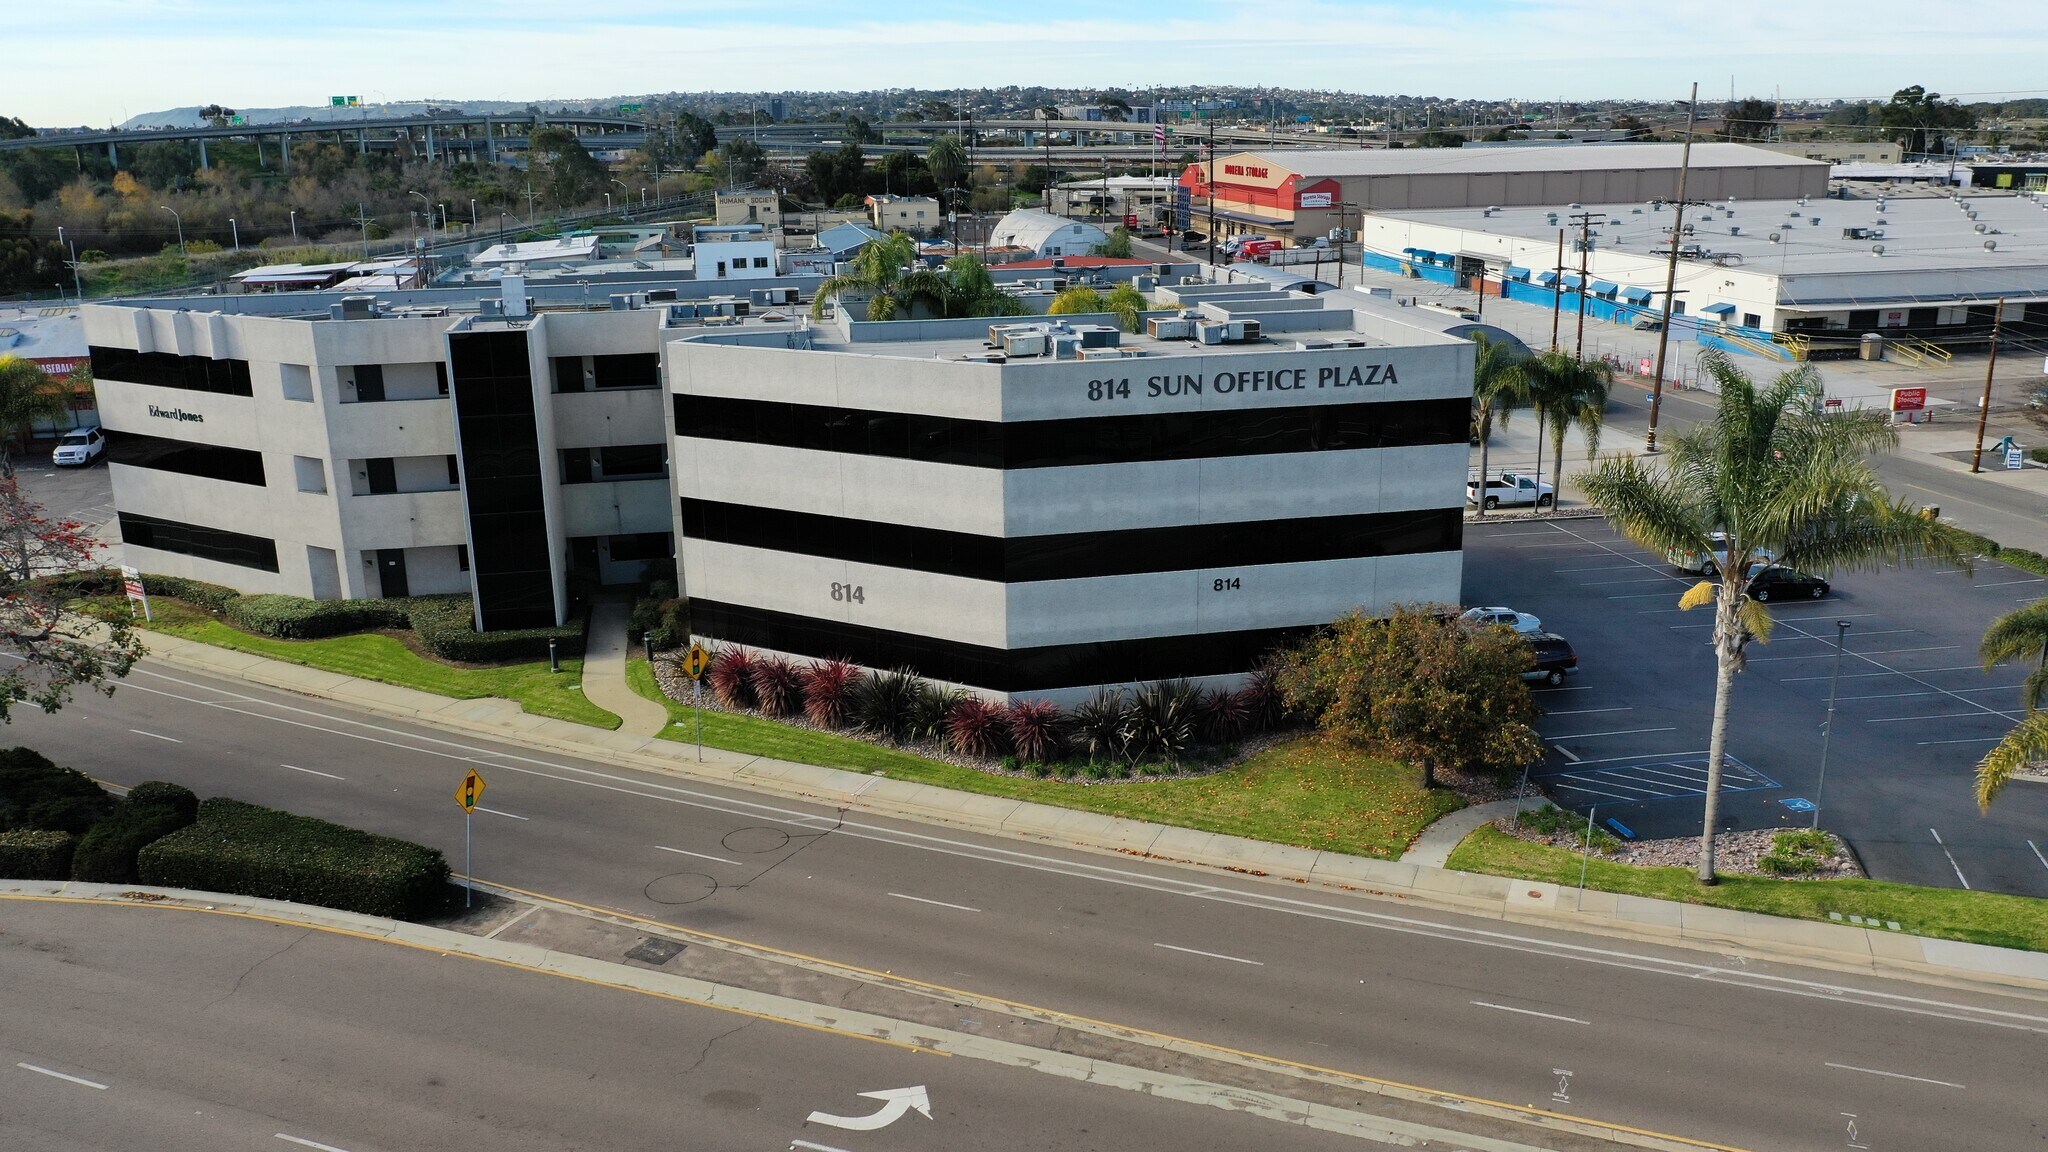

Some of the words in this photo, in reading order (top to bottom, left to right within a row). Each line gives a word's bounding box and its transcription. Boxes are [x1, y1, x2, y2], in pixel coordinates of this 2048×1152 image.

[1224, 164, 1244, 176] MORENA
[1245, 166, 1269, 179] STORAGE
[719, 197, 746, 205] HUMANE
[750, 196, 777, 204] SOCIETY
[1087, 378, 1131, 401] 814
[1147, 374, 1203, 398] SUN
[1212, 369, 1307, 394] OFFICE
[1317, 363, 1399, 388] PLAZA
[1896, 396, 1922, 404] Storage
[1213, 577, 1241, 592] 814
[830, 581, 866, 605] 814
